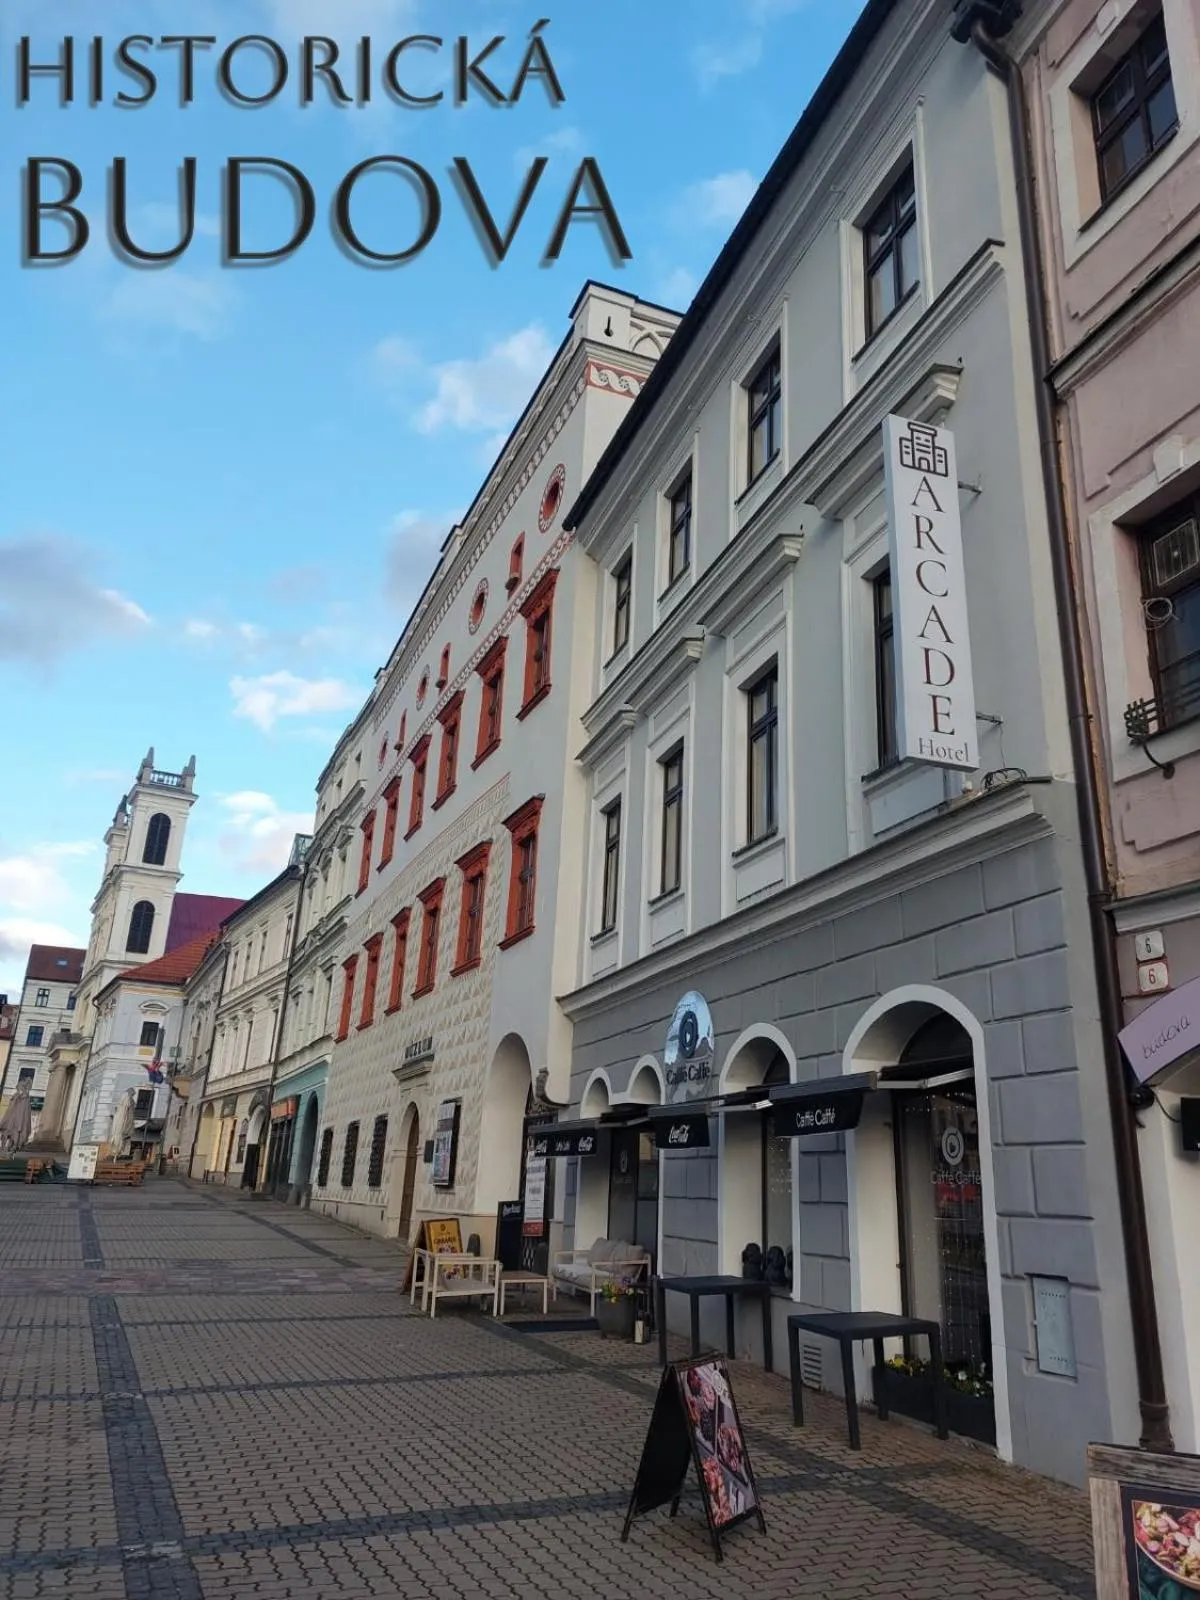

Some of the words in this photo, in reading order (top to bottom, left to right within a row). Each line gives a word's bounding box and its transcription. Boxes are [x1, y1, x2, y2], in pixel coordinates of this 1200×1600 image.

[911, 475, 956, 736] ARCADE
[918, 737, 969, 763] Hotel
[1144, 937, 1153, 954] 6
[1148, 968, 1157, 985] 6
